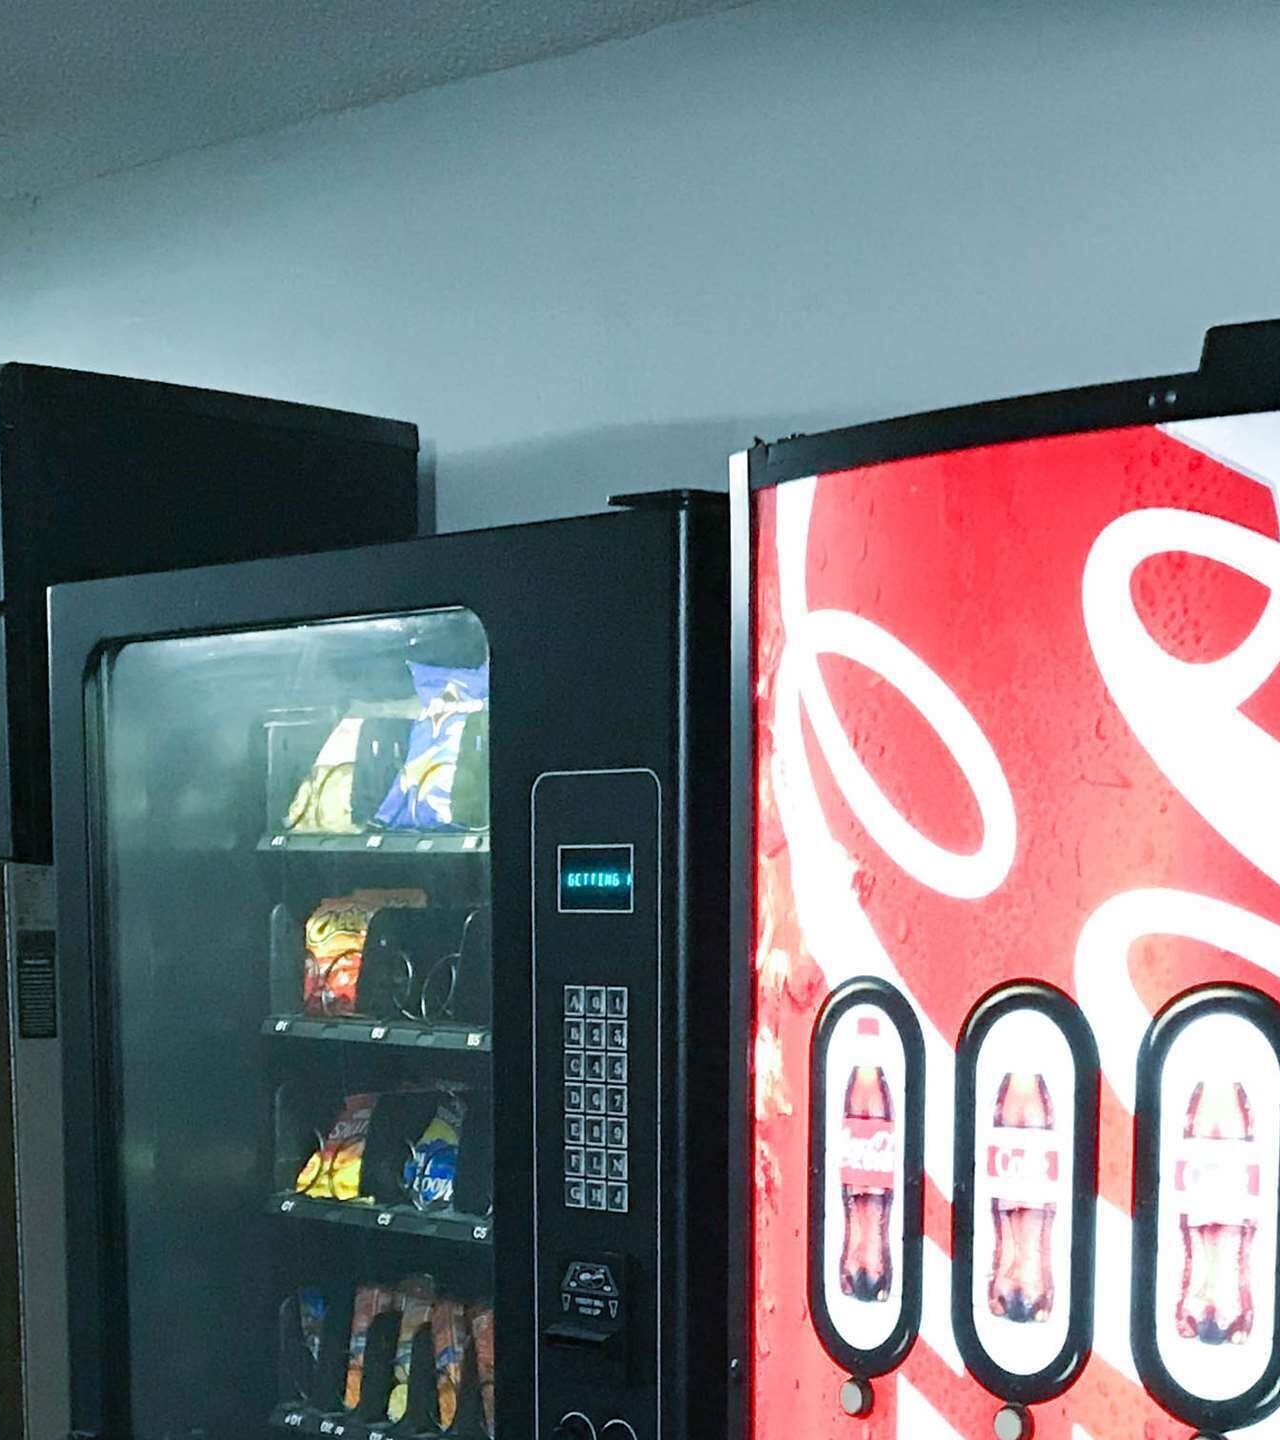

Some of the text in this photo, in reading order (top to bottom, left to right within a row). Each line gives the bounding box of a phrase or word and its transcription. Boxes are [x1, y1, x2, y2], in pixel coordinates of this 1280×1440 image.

[568, 872, 620, 887] GETTING
[570, 1058, 581, 1073] C
[570, 1122, 580, 1137] E
